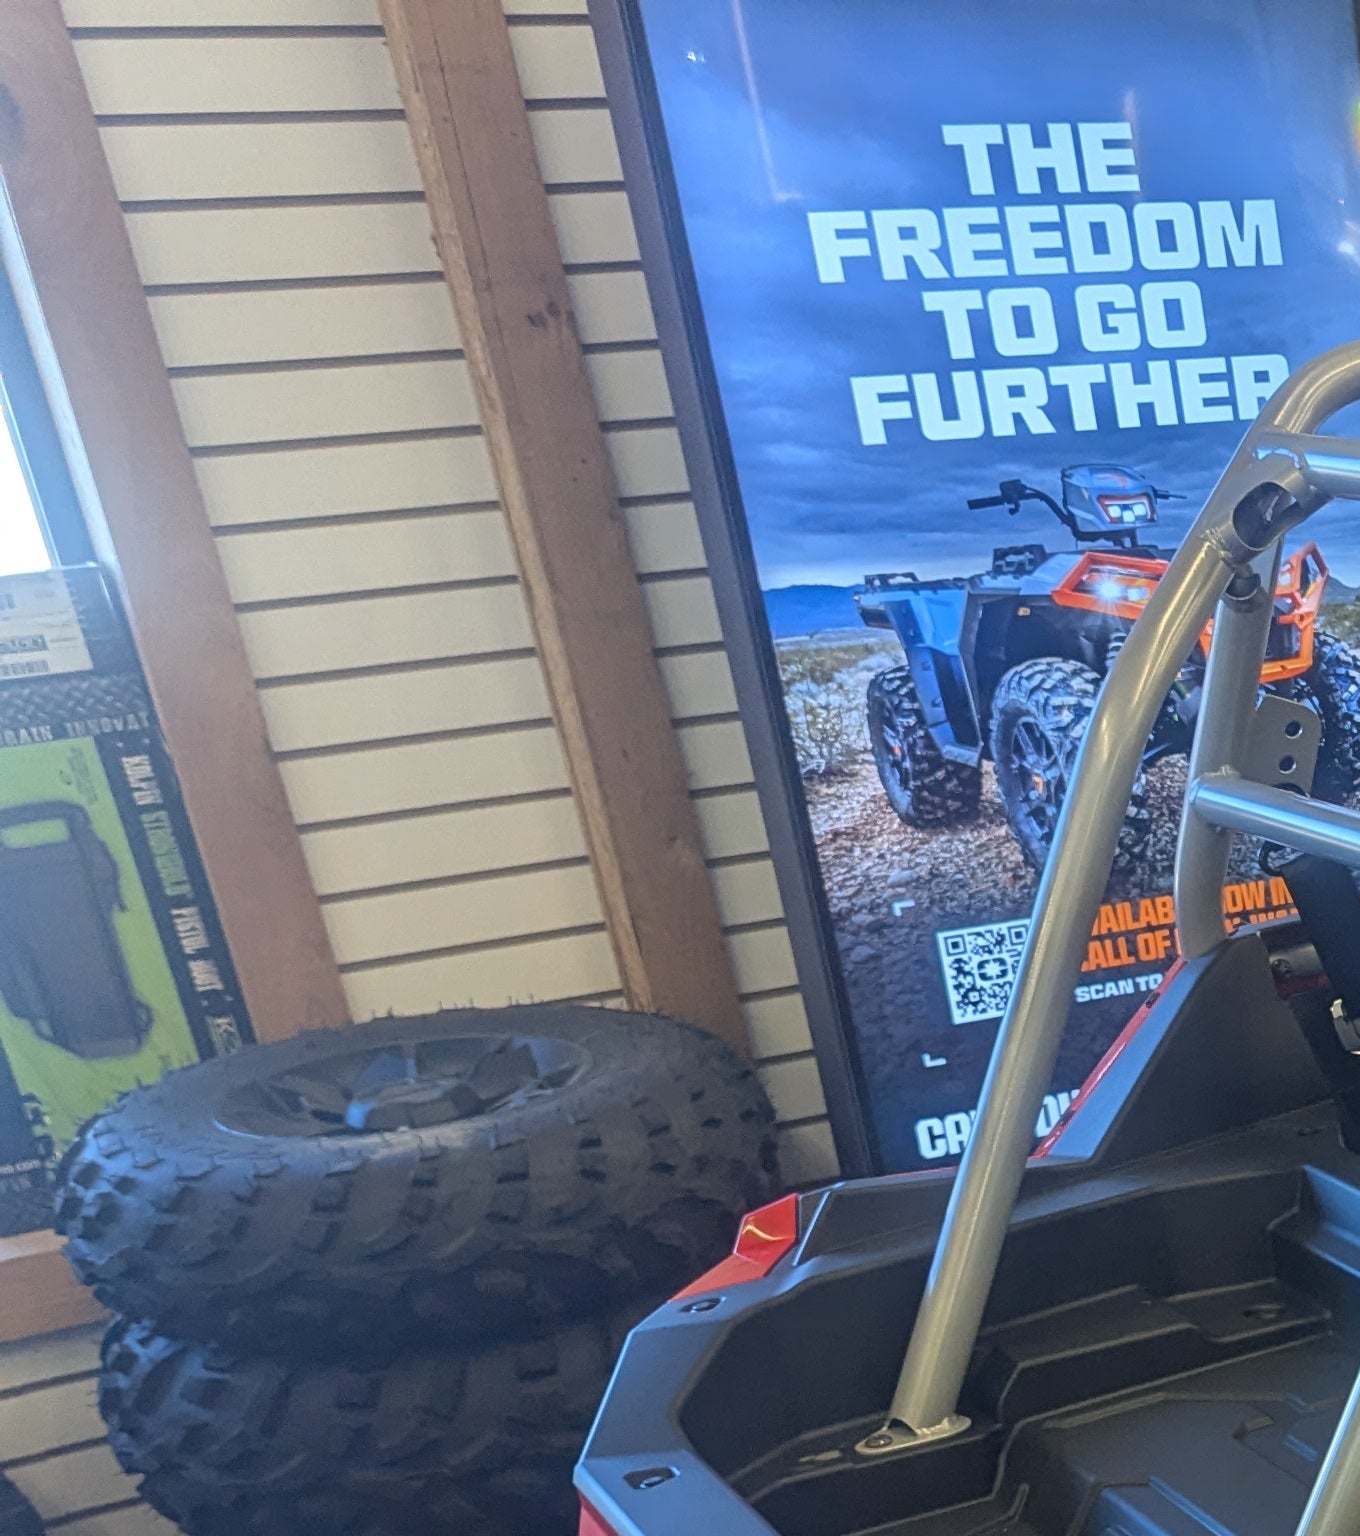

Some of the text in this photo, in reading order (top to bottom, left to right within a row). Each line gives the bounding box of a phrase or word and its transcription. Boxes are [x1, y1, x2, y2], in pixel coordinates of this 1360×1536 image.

[942, 121, 1140, 195] THE
[807, 199, 1283, 284] FREEDOM
[922, 280, 1207, 360] TO GO
[850, 353, 1290, 446] FURTHER
[64, 712, 149, 738] INNOVAT
[1092, 894, 1176, 937] AILAB
[1223, 880, 1265, 914] OW
[1081, 932, 1136, 973] ALL
[1137, 928, 1171, 961] OF
[1074, 973, 1164, 1003] SCAN TO
